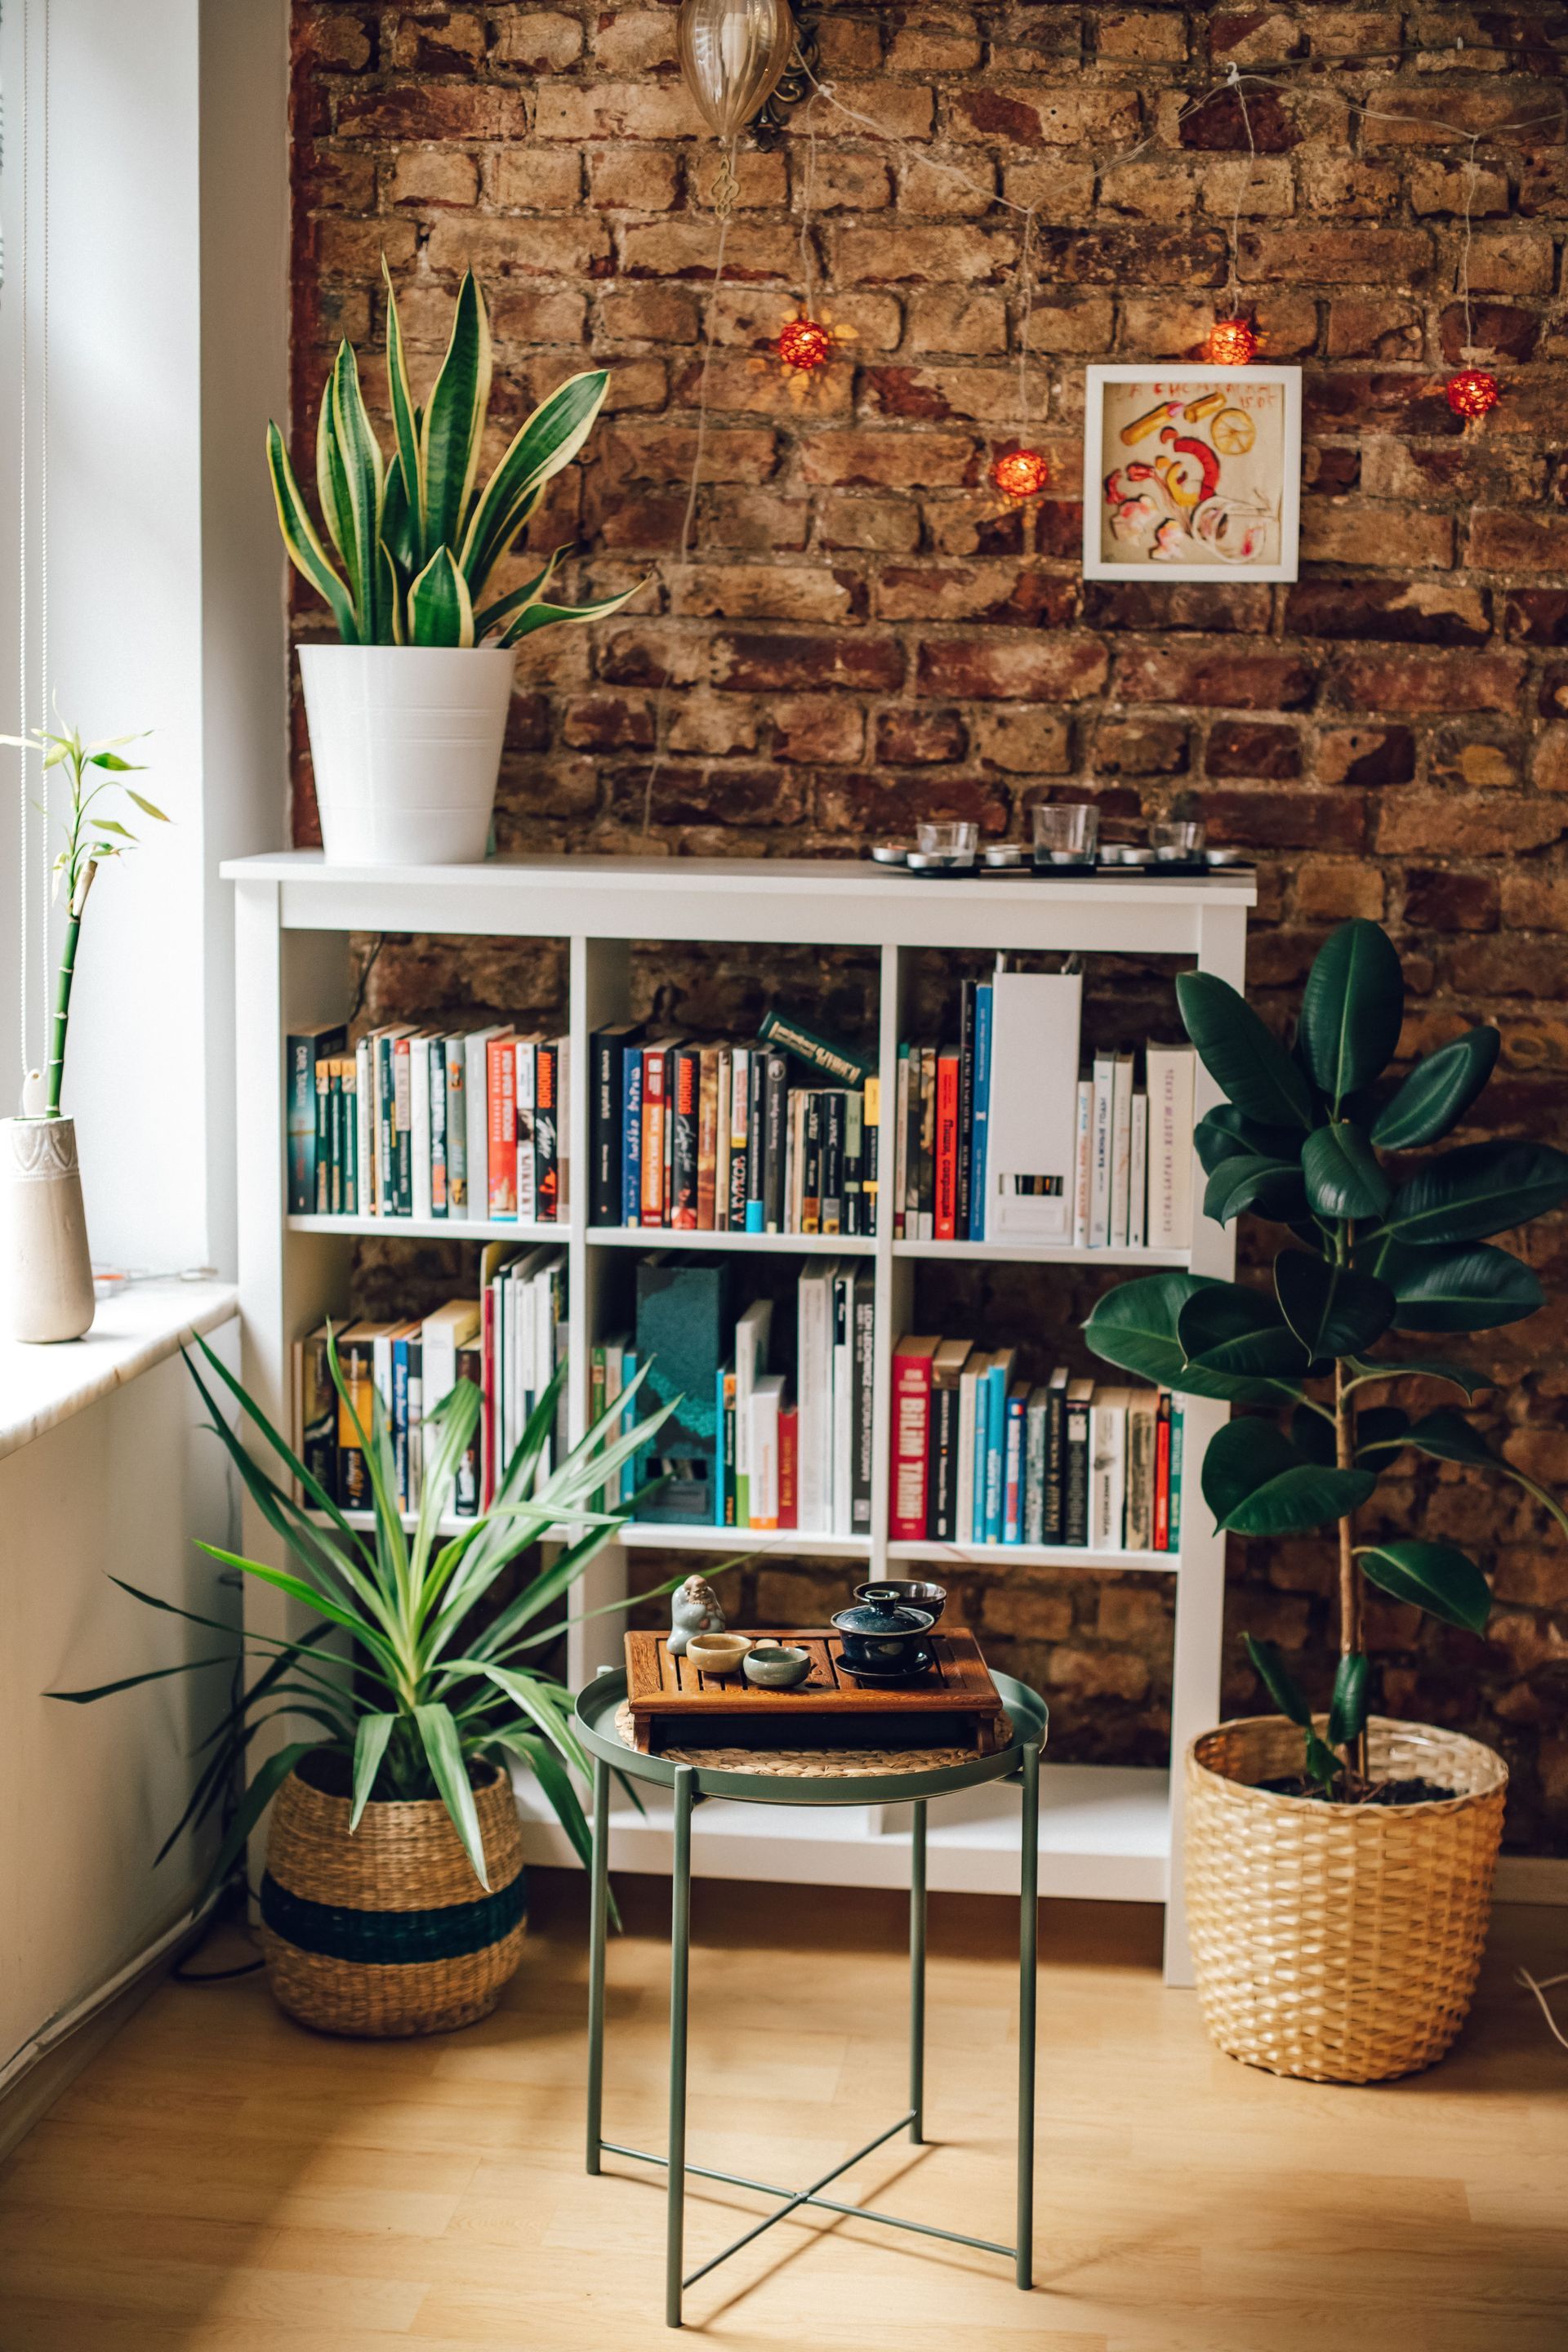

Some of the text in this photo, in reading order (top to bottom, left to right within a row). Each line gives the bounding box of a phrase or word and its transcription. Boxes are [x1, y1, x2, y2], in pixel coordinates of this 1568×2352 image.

[537, 1052, 552, 1109] ЛИМОНОВ
[679, 1058, 693, 1115] ЛИМОНОВ
[942, 1120, 954, 1156] Пиши,
[731, 1156, 746, 1209] КУРКОВ
[940, 1159, 951, 1218] сокращай
